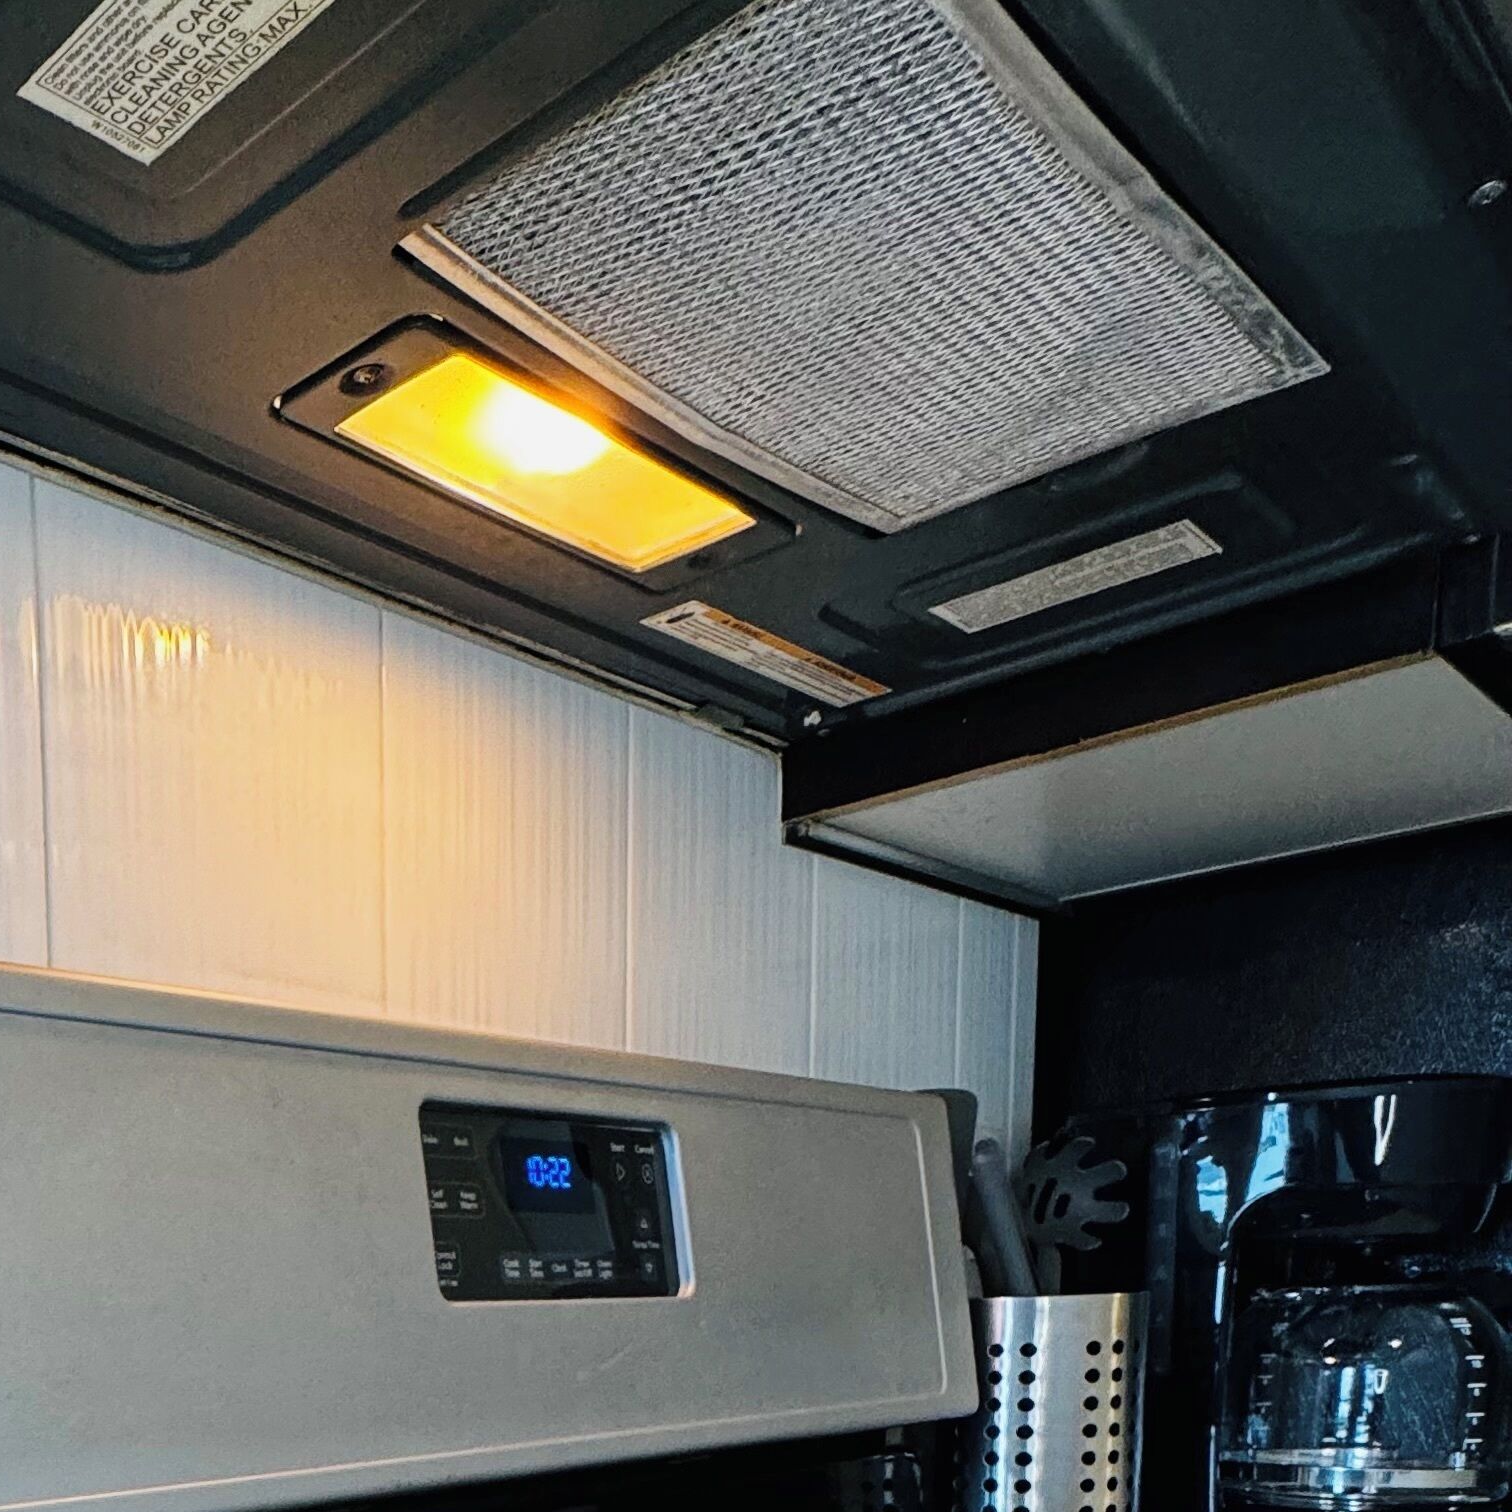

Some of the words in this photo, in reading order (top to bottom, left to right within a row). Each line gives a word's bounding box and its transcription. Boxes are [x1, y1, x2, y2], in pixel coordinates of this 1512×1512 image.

[91, 32, 182, 116] EXERCISE
[110, 44, 199, 125] CLEANING
[127, 28, 254, 136] DETERGENTS.
[144, 100, 193, 146] LAMP
[525, 1155, 572, 1189] 10:22
